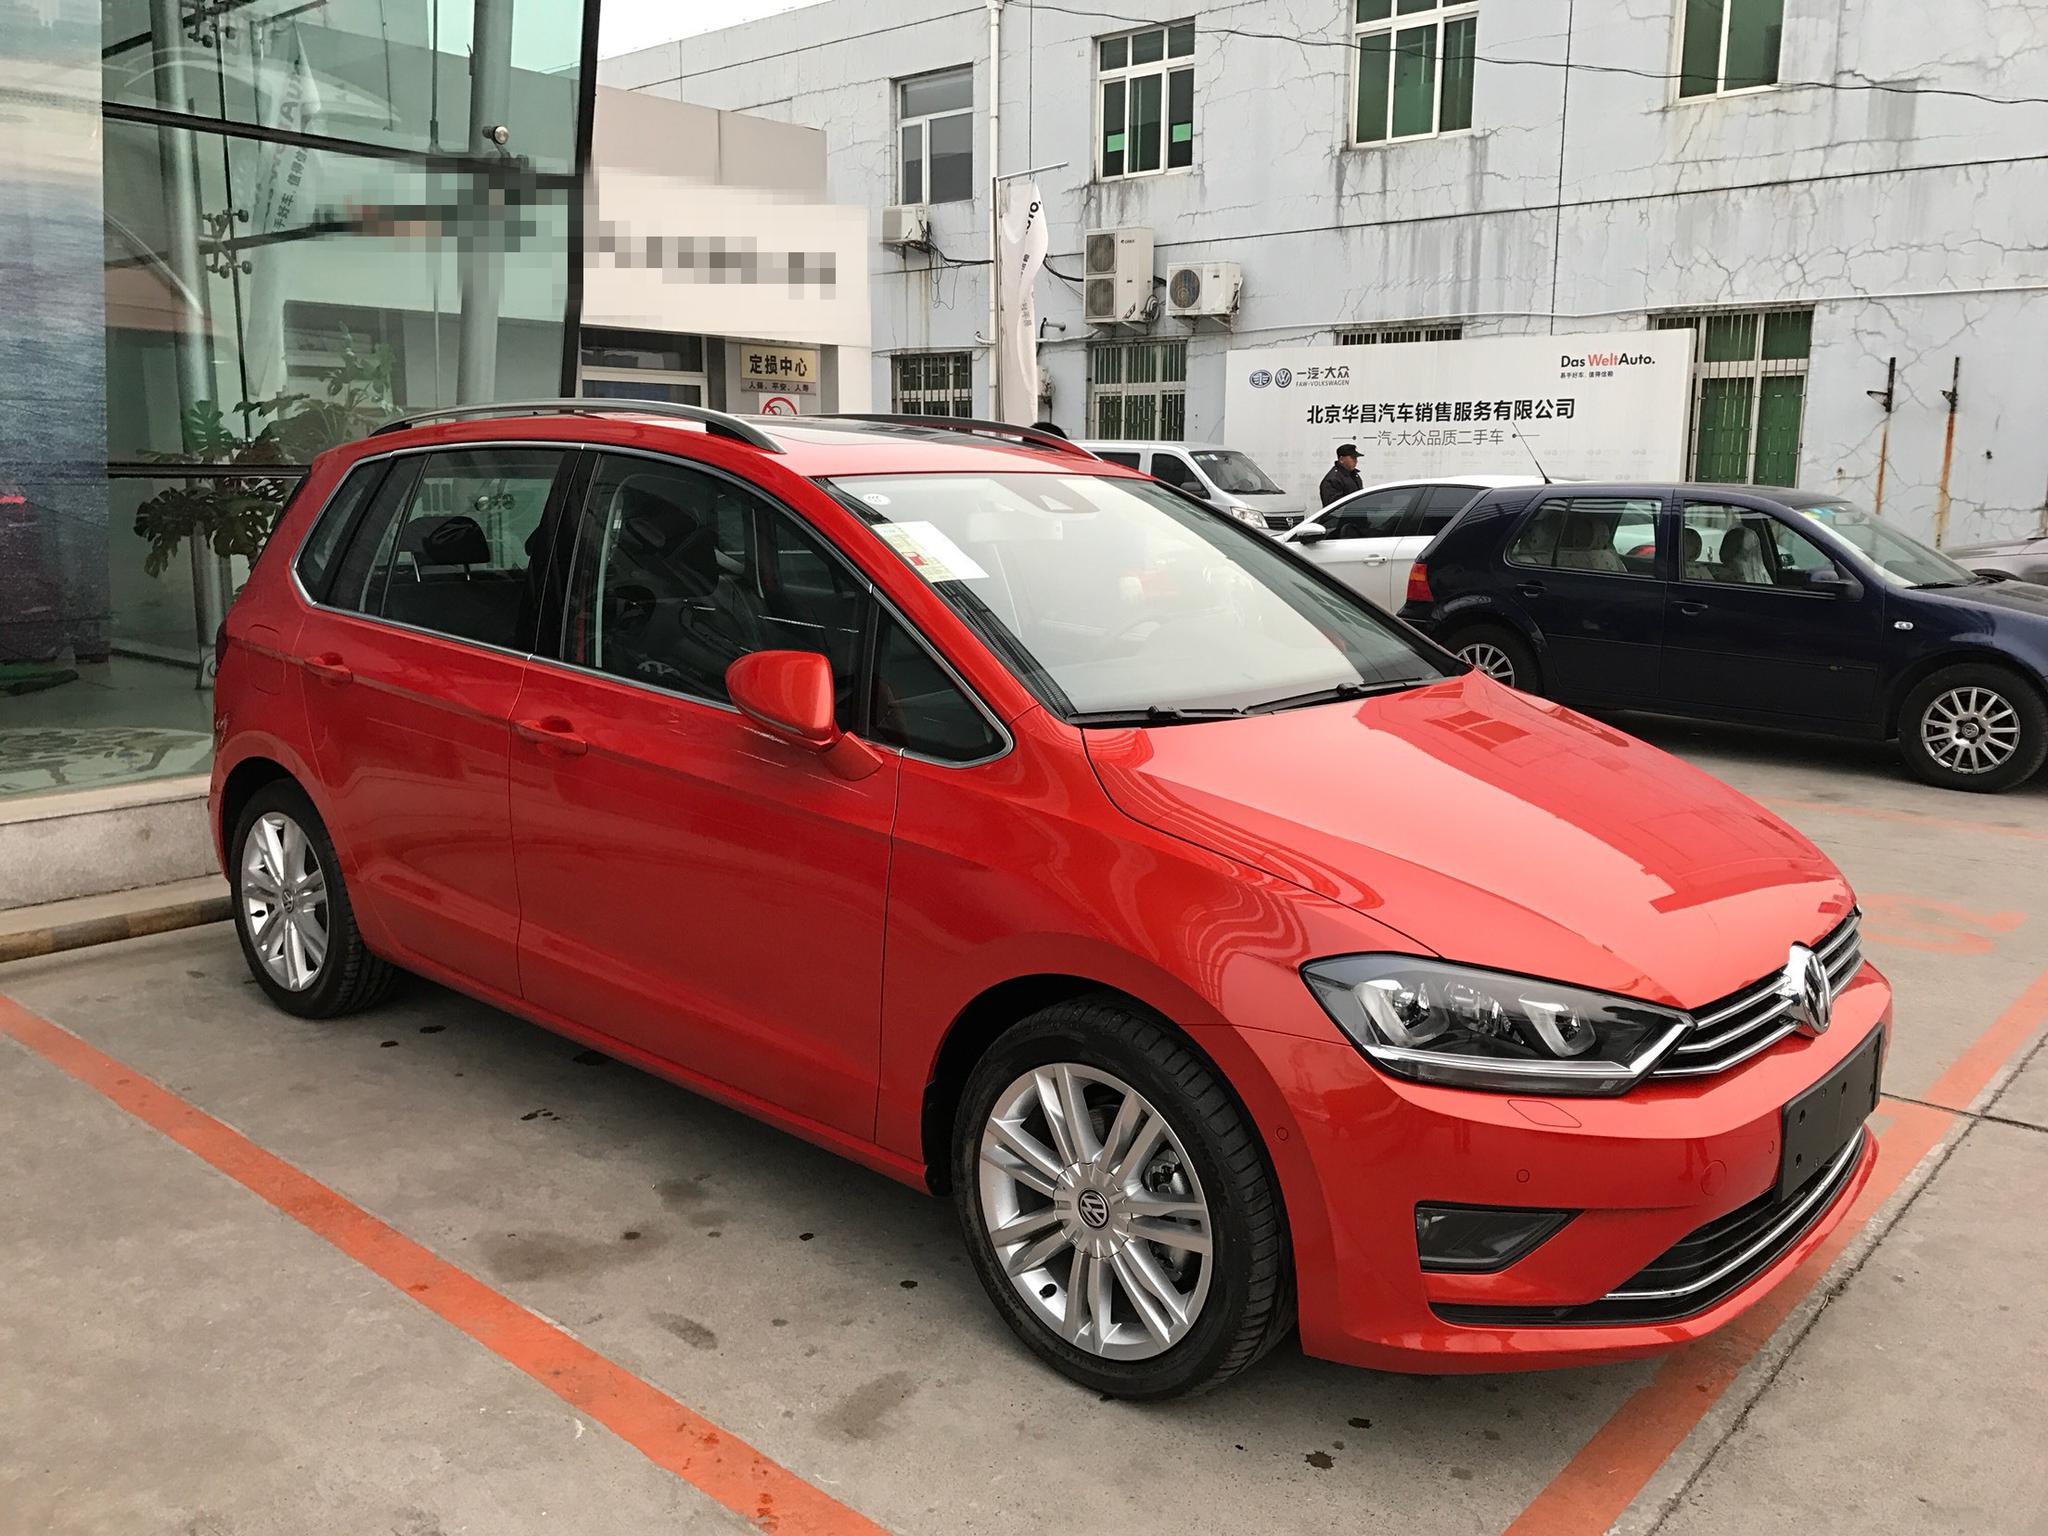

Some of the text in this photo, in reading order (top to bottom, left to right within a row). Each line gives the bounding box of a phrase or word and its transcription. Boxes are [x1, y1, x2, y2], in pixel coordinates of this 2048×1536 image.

[749, 353, 808, 377] 定损中心
[1560, 355, 1586, 368] Das
[1306, 398, 1576, 425] 北京华昌汽车销售服务有限公司
[1362, 428, 1505, 446] 一汽-大众品质二手车
